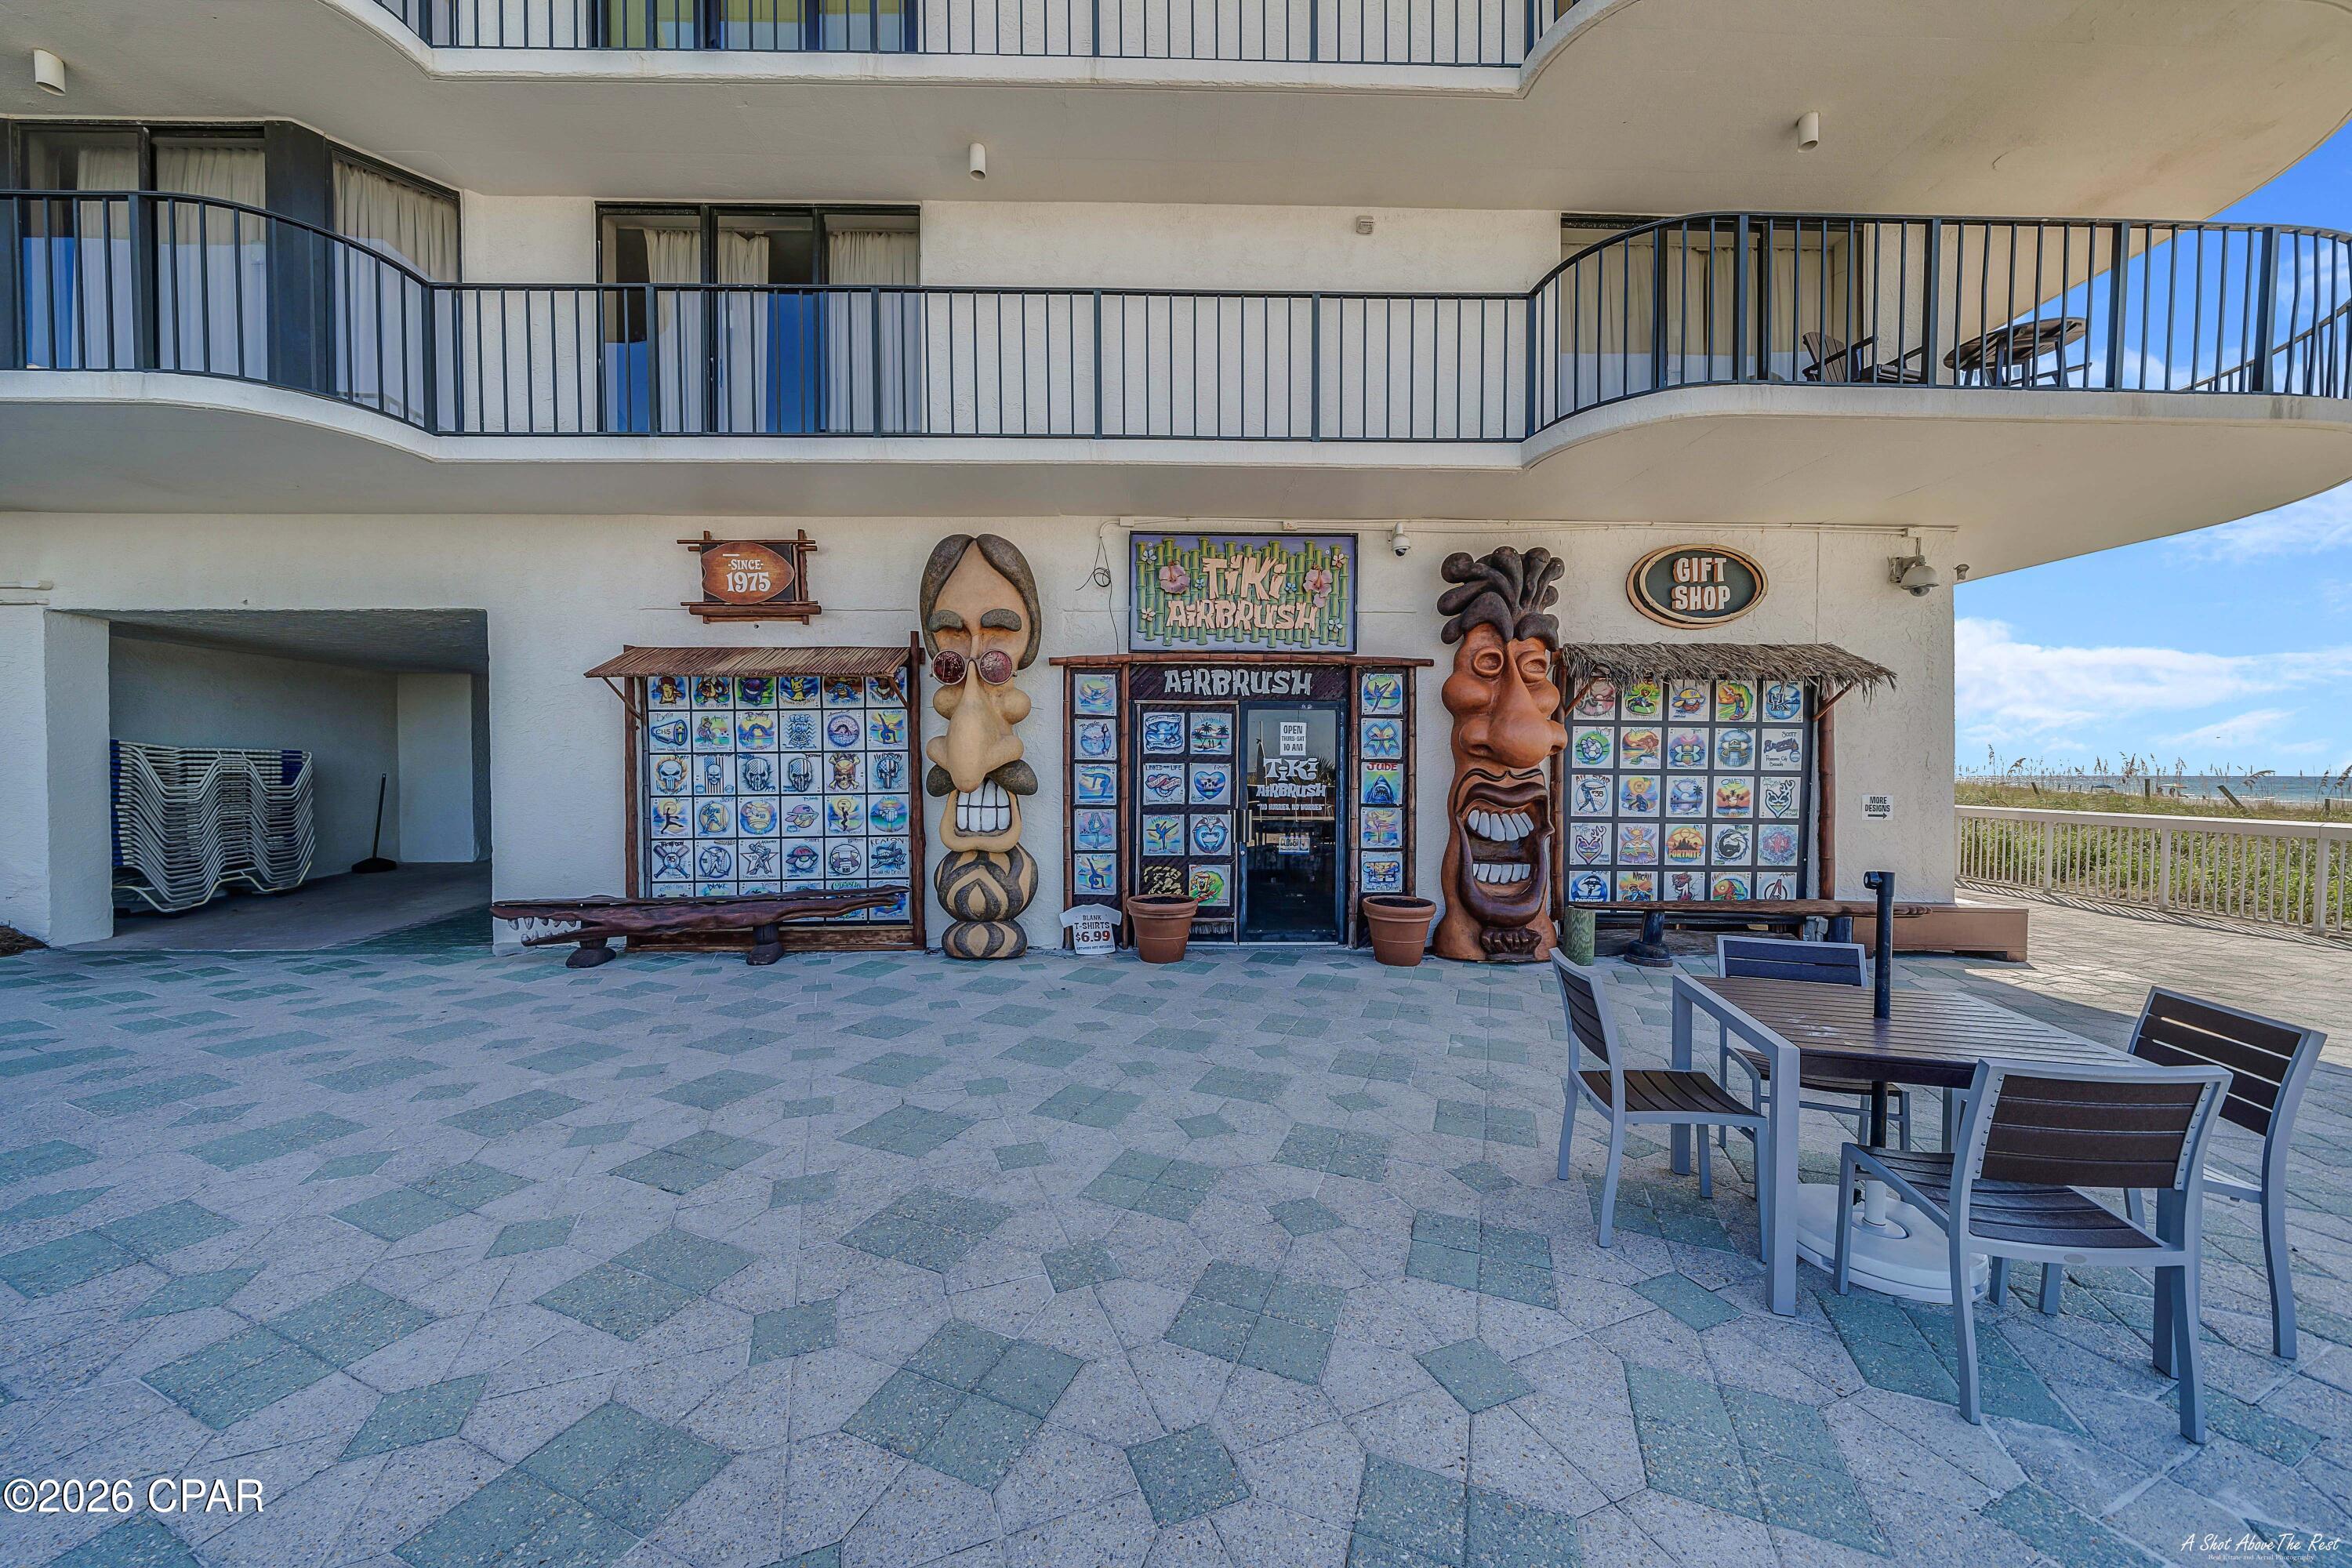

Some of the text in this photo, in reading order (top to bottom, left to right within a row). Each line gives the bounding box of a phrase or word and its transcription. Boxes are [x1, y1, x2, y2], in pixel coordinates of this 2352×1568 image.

[1672, 557, 1727, 583] GIFT
[726, 572, 771, 593] 1975
[1671, 585, 1731, 612] SHOP
[1283, 725, 1303, 734] OPEN
[873, 753, 903, 761] HUDSON
[1367, 762, 1398, 771] JUDE
[1575, 775, 1611, 786] ALL STAR
[1280, 838, 1299, 847] CLOSED
[1668, 849, 1701, 858] FORTNITE
[1074, 921, 1110, 930] T-SHIRTS
[1075, 931, 1110, 943] $6.99
